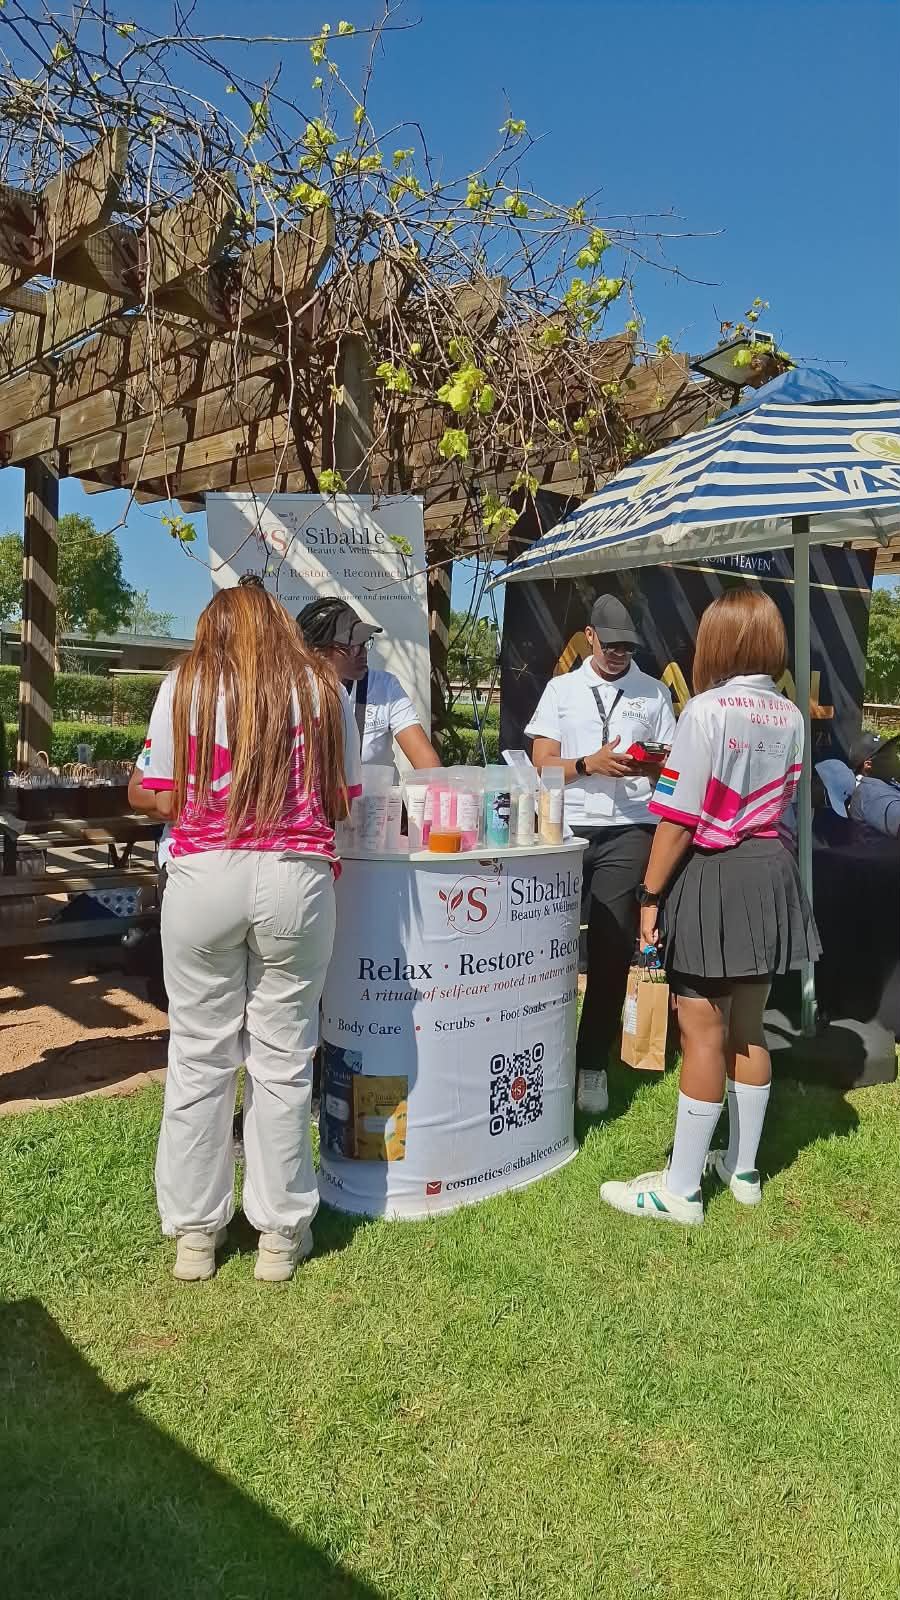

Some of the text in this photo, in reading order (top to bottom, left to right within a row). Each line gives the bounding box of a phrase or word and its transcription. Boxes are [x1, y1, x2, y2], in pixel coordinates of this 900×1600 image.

[305, 528, 385, 544] Sibahle
[718, 696, 755, 709] WOMEN
[758, 696, 767, 709] IN
[750, 712, 788, 727] GOLF DAY
[510, 871, 580, 906] Sibahle
[510, 909, 541, 922] Beauty
[543, 904, 551, 916] &
[357, 957, 433, 981] Relax
[458, 949, 534, 976] Restore
[360, 988, 371, 1001] A
[375, 986, 420, 1001] ritual
[422, 986, 438, 1003] of
[439, 983, 490, 1001] self-care
[493, 973, 526, 992] rooted
[527, 974, 537, 985] in
[539, 966, 565, 983] nature
[338, 1018, 364, 1037] Body
[368, 1022, 402, 1035] Care
[434, 1017, 476, 1032] Scrubs
[500, 1009, 520, 1022] Foot
[522, 1001, 547, 1017] Soaks
